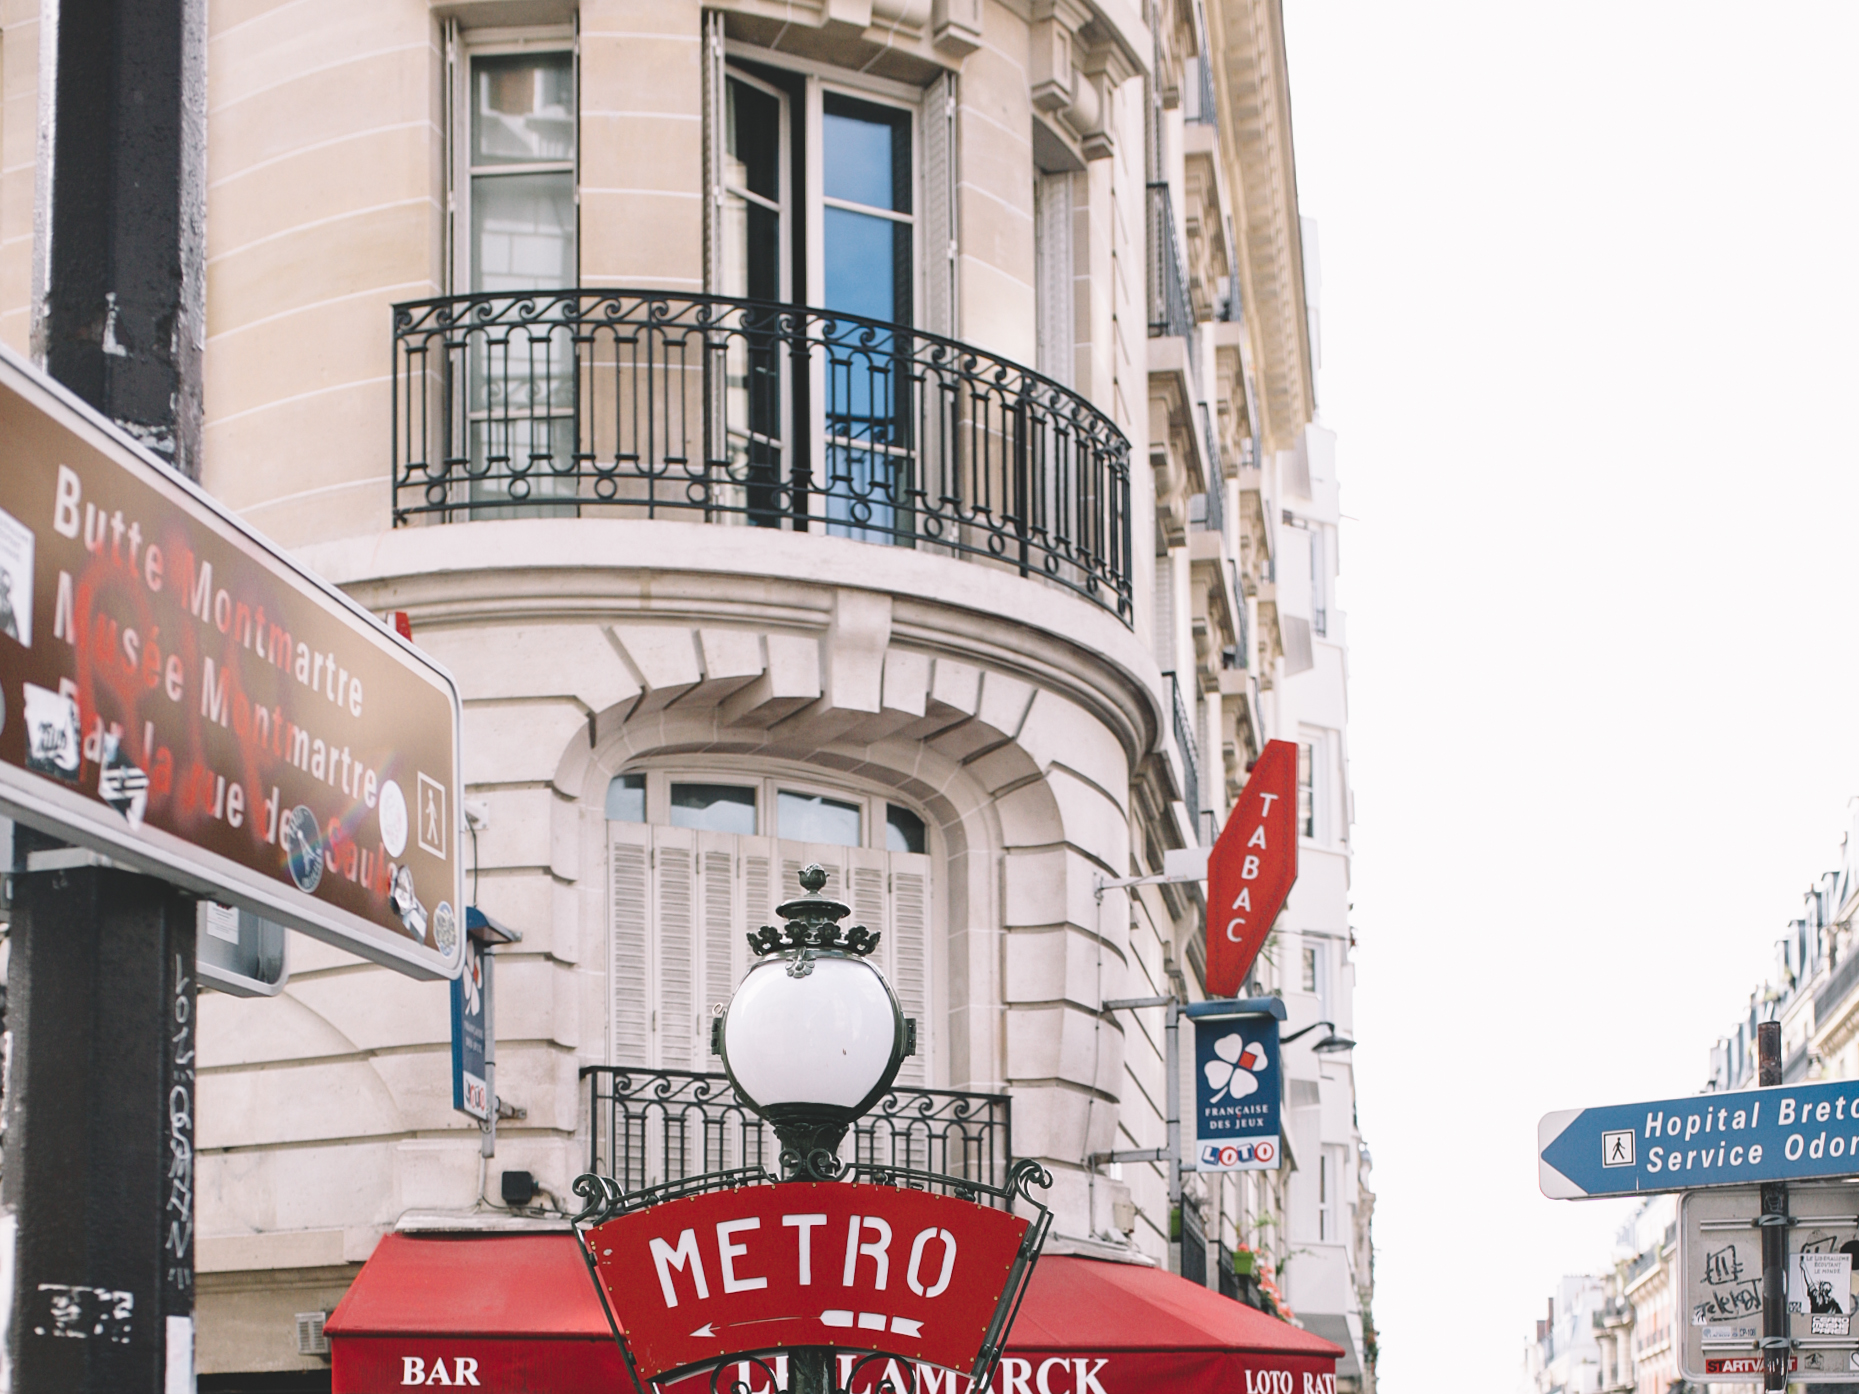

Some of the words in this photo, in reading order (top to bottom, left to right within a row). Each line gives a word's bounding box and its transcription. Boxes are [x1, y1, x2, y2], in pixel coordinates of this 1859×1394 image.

[52, 463, 163, 592] Butte
[182, 549, 363, 718] Montmartre
[201, 656, 378, 809] Montmartre
[1226, 792, 1278, 943] TABAC
[1209, 1119, 1231, 1130] DES
[1235, 1117, 1264, 1130] JEUX
[1644, 1101, 1760, 1142] Hopital
[1201, 1141, 1275, 1167] LOTO
[1646, 1141, 1763, 1173] Service
[648, 1213, 958, 1309] METRO
[401, 1356, 481, 1387] BAR
